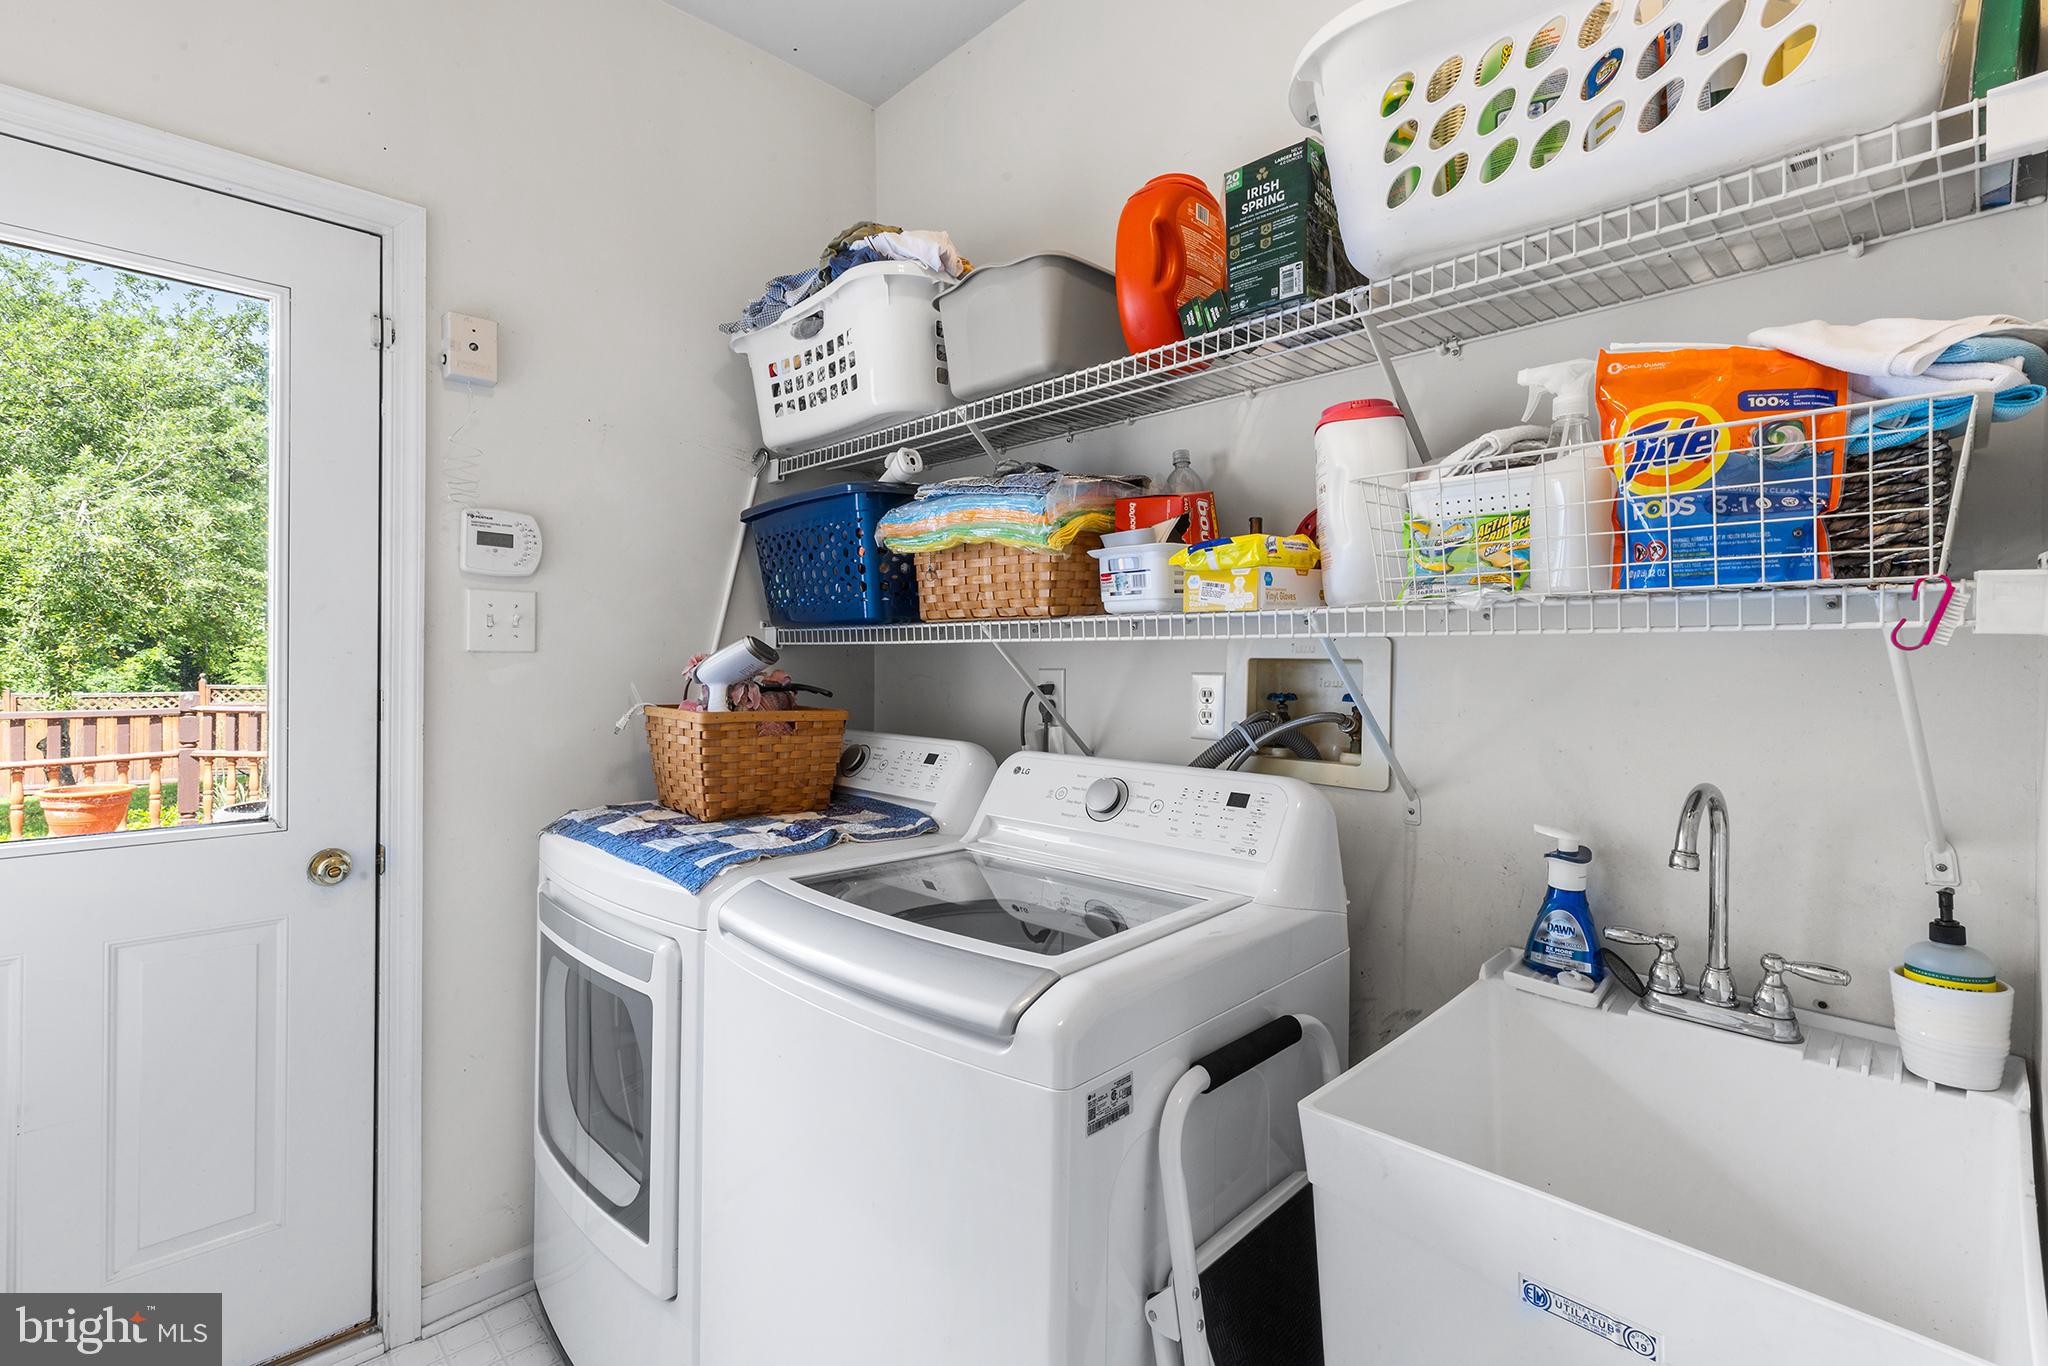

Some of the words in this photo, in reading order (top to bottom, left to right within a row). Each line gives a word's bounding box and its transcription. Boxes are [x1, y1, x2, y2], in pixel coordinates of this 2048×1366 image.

[1226, 172, 1240, 185] 20
[1247, 179, 1280, 200] IRISH
[1241, 190, 1285, 215] SPRING
[1748, 396, 1790, 407] 100%
[1620, 416, 1720, 488] Tide
[1547, 922, 1576, 936] DAWN
[1555, 1300, 1615, 1333] UTILATUB
[1635, 1341, 1648, 1353] 19
